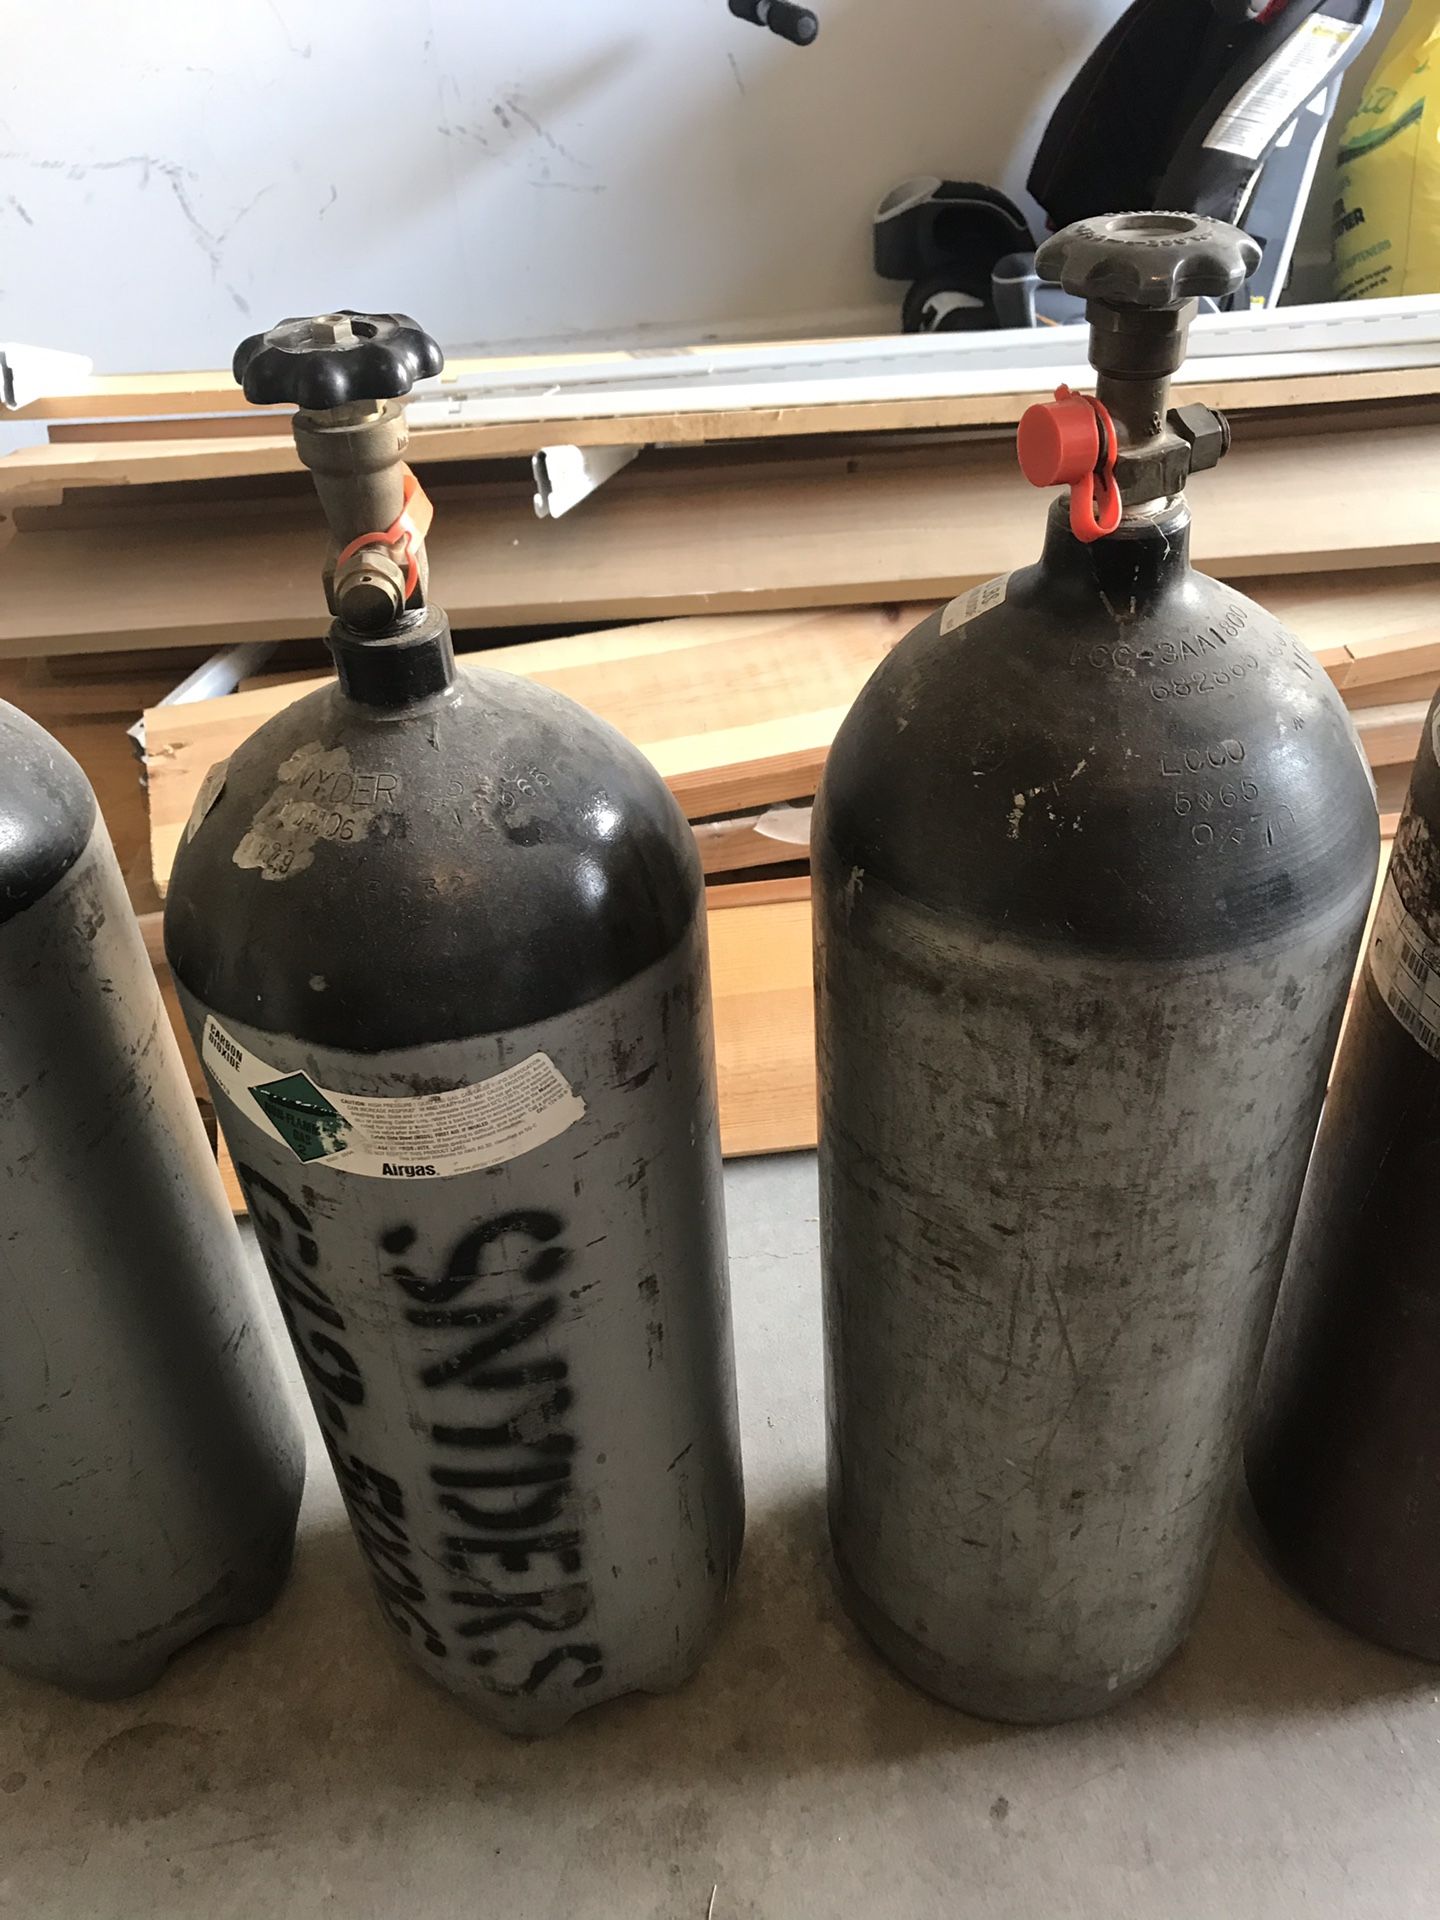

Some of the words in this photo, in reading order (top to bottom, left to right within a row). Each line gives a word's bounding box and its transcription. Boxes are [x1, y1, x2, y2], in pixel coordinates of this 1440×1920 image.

[208, 1033, 241, 1073] DIOXIDE
[210, 1023, 243, 1063] CARBON
[382, 1163, 436, 1178] Airgas
